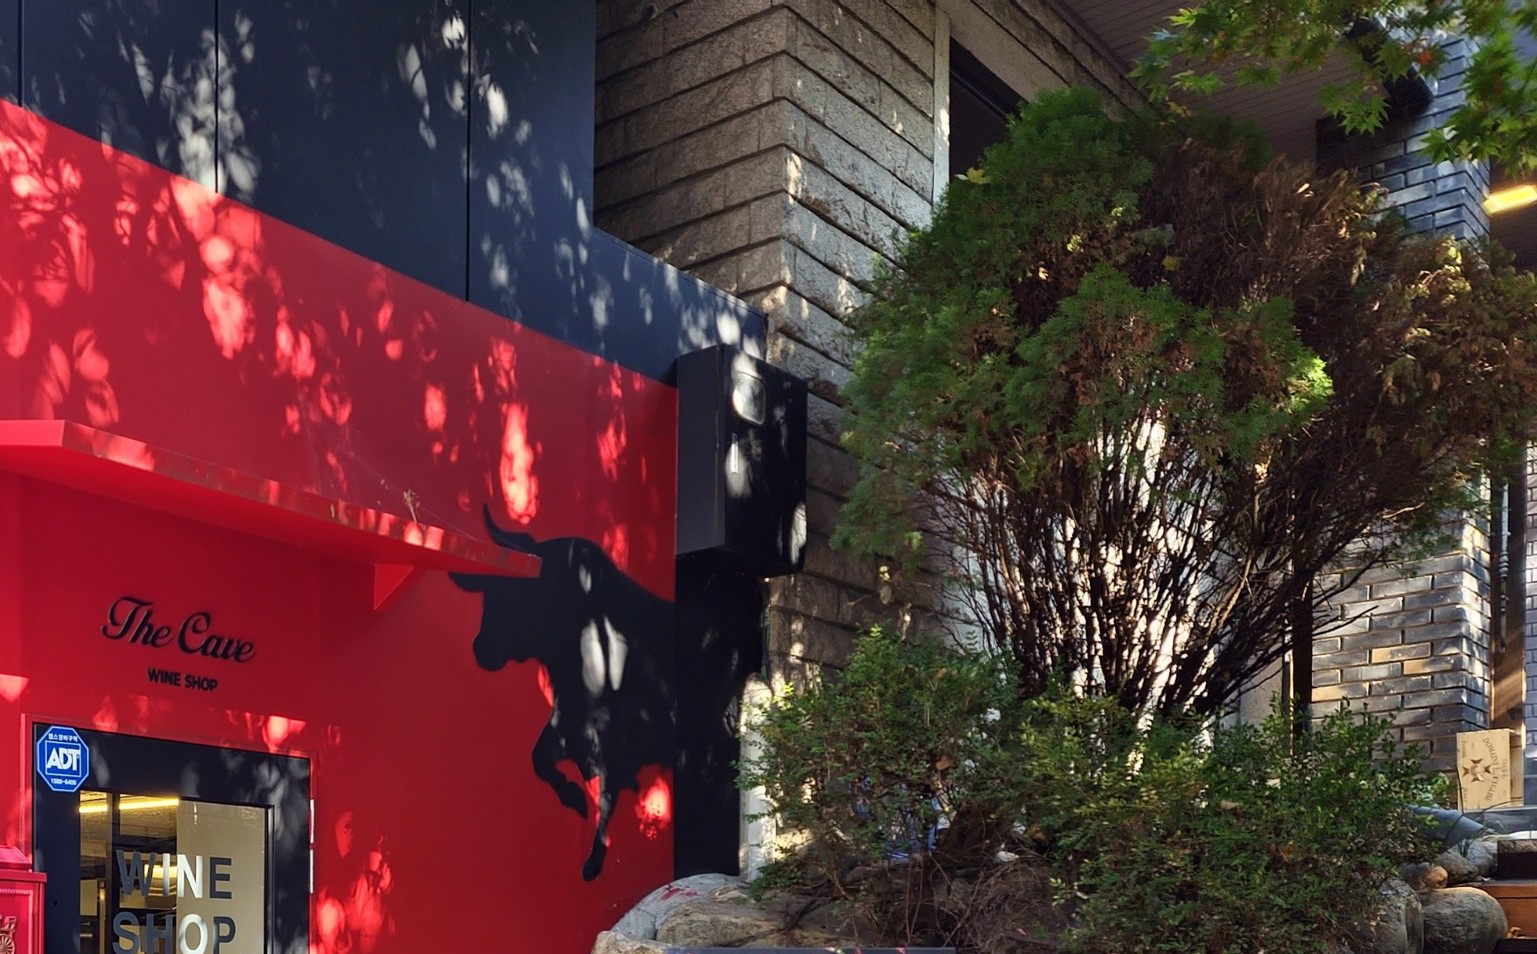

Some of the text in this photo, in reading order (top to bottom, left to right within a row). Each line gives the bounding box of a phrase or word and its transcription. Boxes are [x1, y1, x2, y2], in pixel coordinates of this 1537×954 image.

[101, 596, 257, 664] The Cave
[147, 668, 218, 692] WINE SHOP
[46, 747, 81, 771] ADT
[115, 849, 233, 899] WINE
